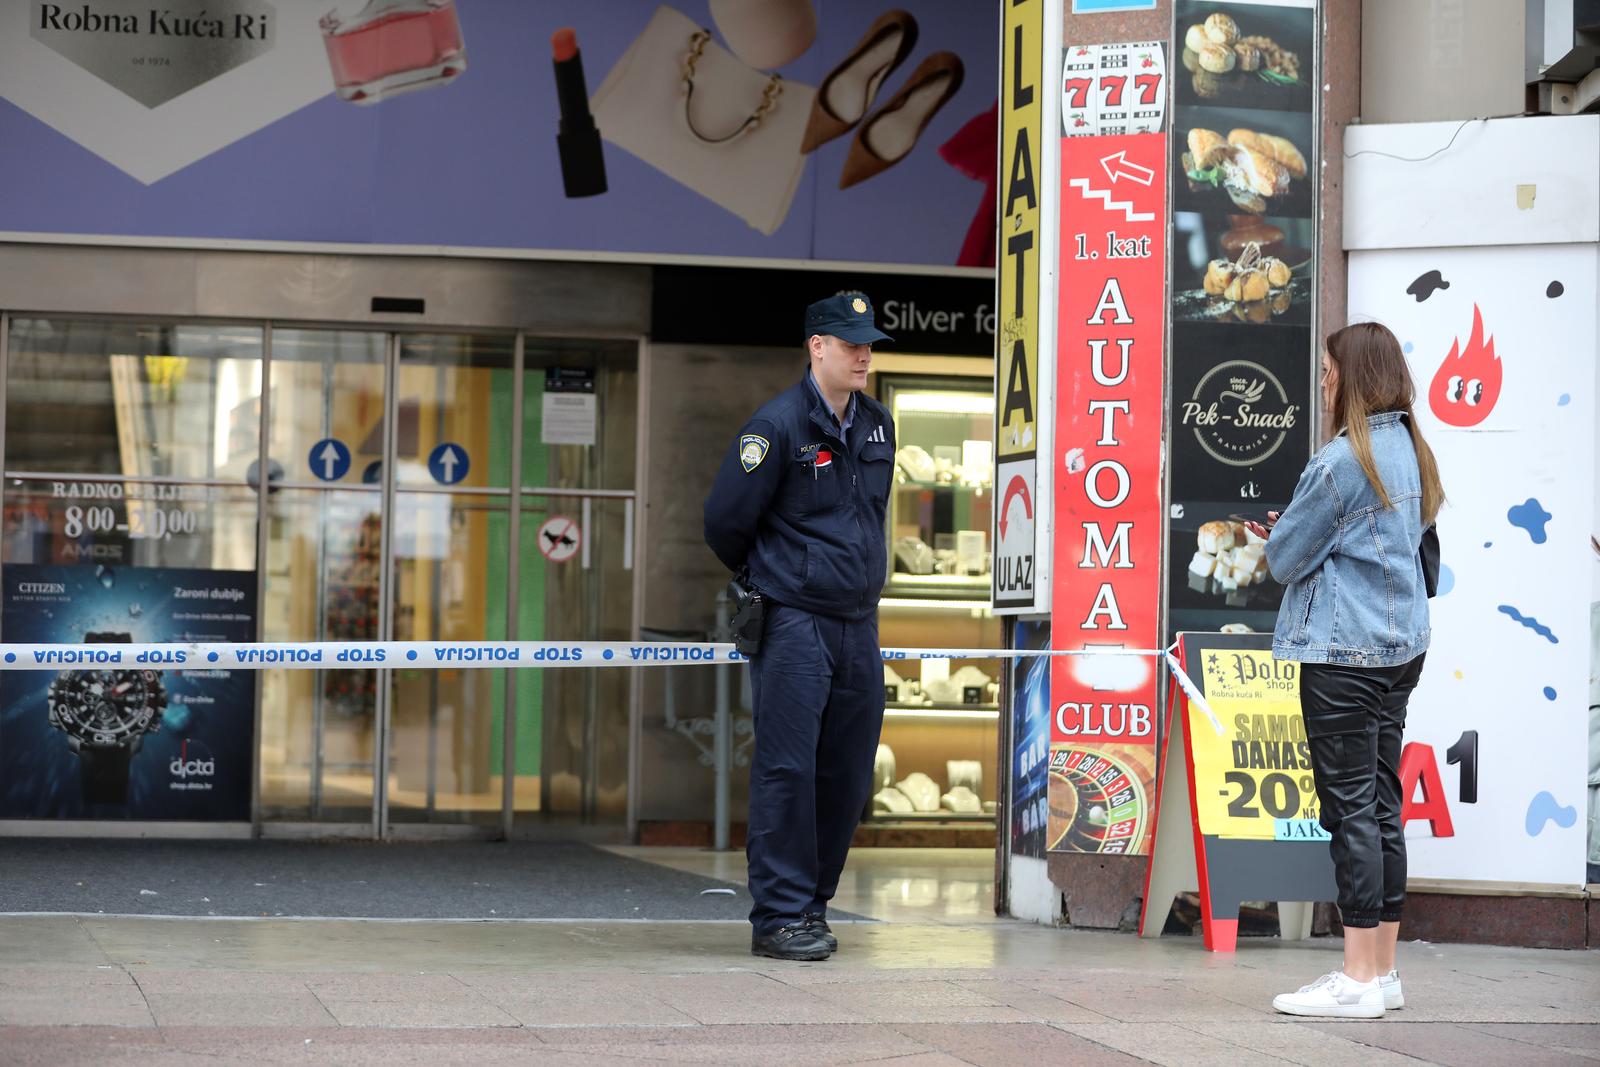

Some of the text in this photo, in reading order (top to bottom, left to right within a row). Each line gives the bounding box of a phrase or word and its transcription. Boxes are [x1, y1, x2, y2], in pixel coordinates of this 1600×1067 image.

[40, 4, 267, 40] Robna Kuća Ri
[1065, 73, 1162, 108] 7 7 7
[1005, 0, 1037, 427] LATA
[1074, 231, 1151, 260] 1. kat
[883, 300, 965, 333] Silver
[742, 437, 767, 449] POLICIJA
[1211, 431, 1268, 452] FRANCHISE
[51, 482, 123, 499] RADNO
[1077, 278, 1135, 691] AUTOMA
[19, 582, 65, 594] CITIZEN
[998, 555, 1033, 592] ULAZ
[174, 587, 245, 602] Zaroni dublje
[33, 650, 187, 663] STOP POLICIJA
[236, 648, 386, 662] STOP POLICIJA
[434, 647, 583, 661] STOP POLICIJA
[631, 647, 715, 660] POLICIJA
[1231, 654, 1295, 684] Polo
[1211, 690, 1235, 698] Robna
[1255, 690, 1262, 699] Ri
[1266, 680, 1294, 692] shop
[1056, 702, 1151, 736] CLUB
[1234, 714, 1307, 743] SAMO
[1020, 733, 1046, 778] BAR
[1231, 740, 1313, 770] DANAS
[1398, 730, 1478, 838] A1
[1021, 797, 1047, 835] BAR
[1303, 808, 1317, 819] NA
[1283, 822, 1330, 838] JAK
